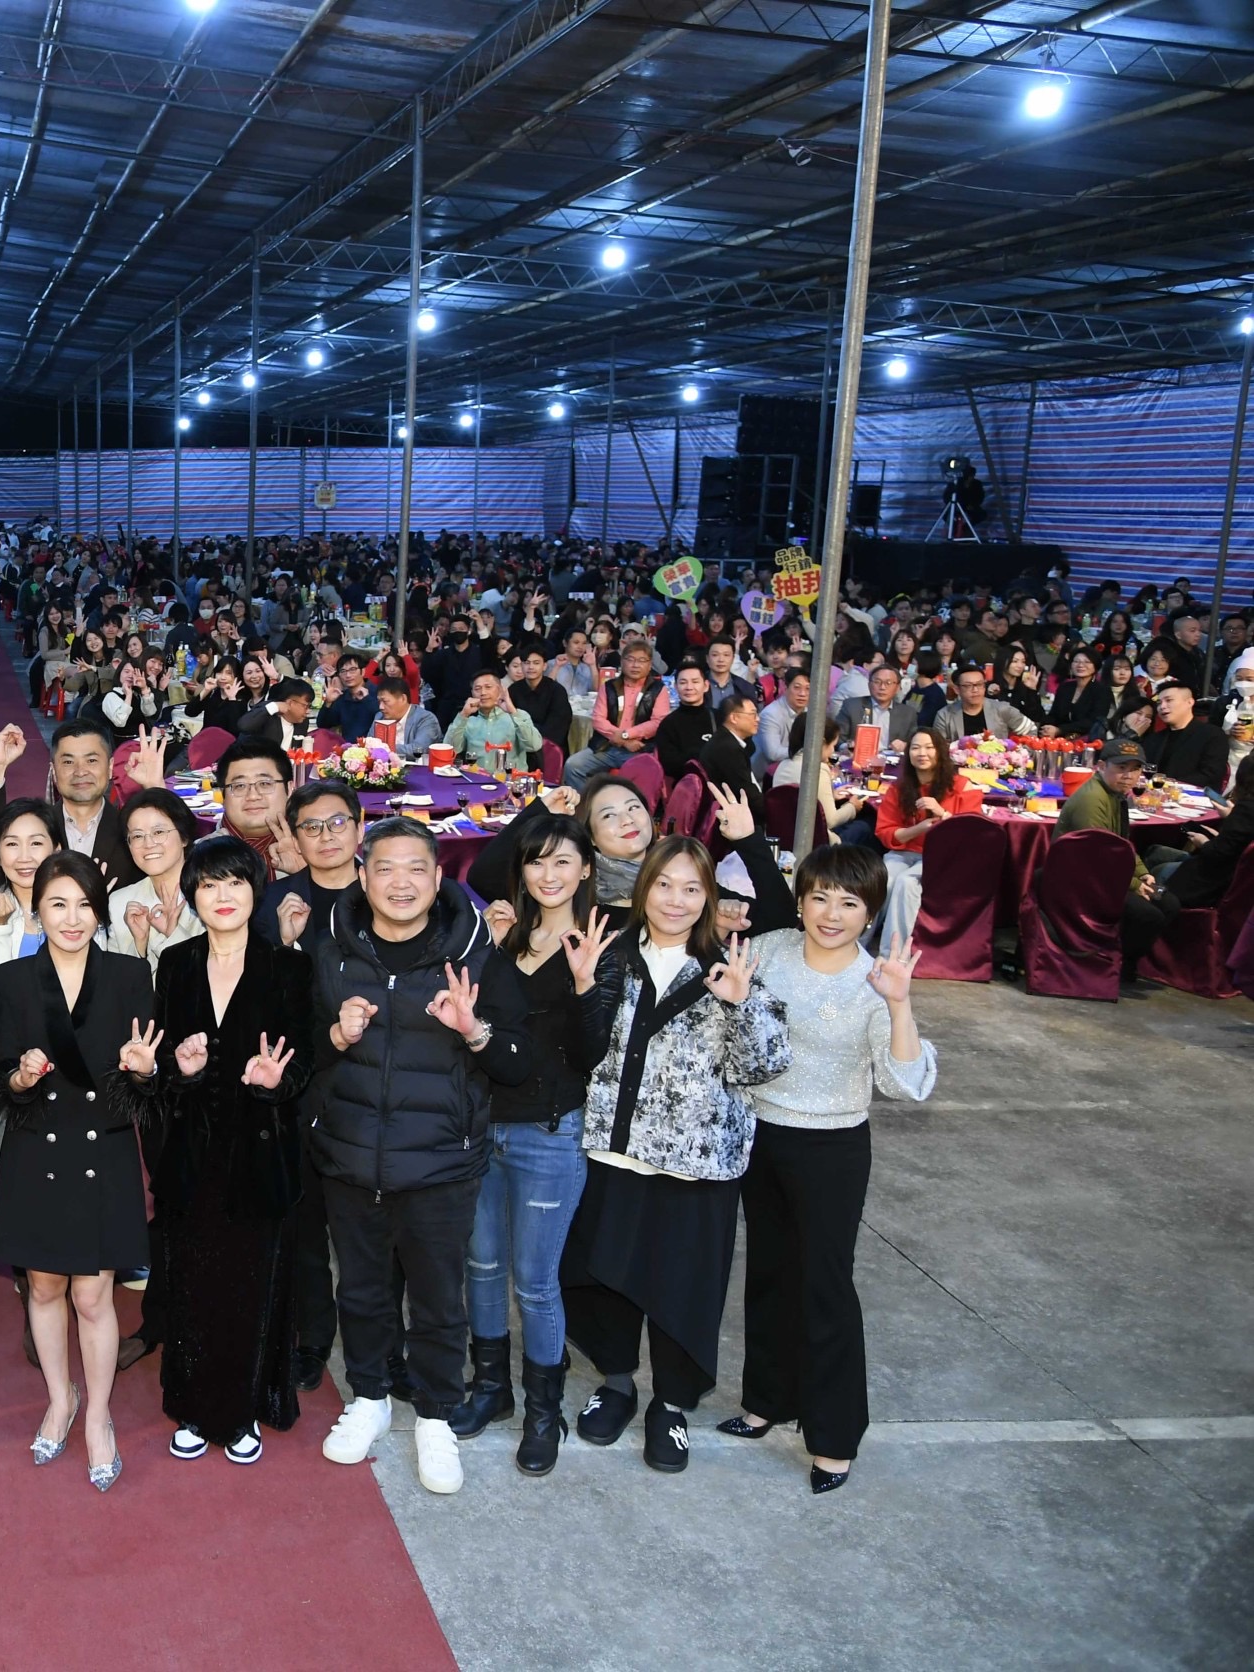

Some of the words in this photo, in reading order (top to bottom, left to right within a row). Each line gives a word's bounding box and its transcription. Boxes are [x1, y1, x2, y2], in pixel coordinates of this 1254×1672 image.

[777, 547, 803, 563] 品牌
[662, 561, 691, 583] 榮華
[784, 557, 812, 573] 行銷
[668, 575, 696, 596] 富貴
